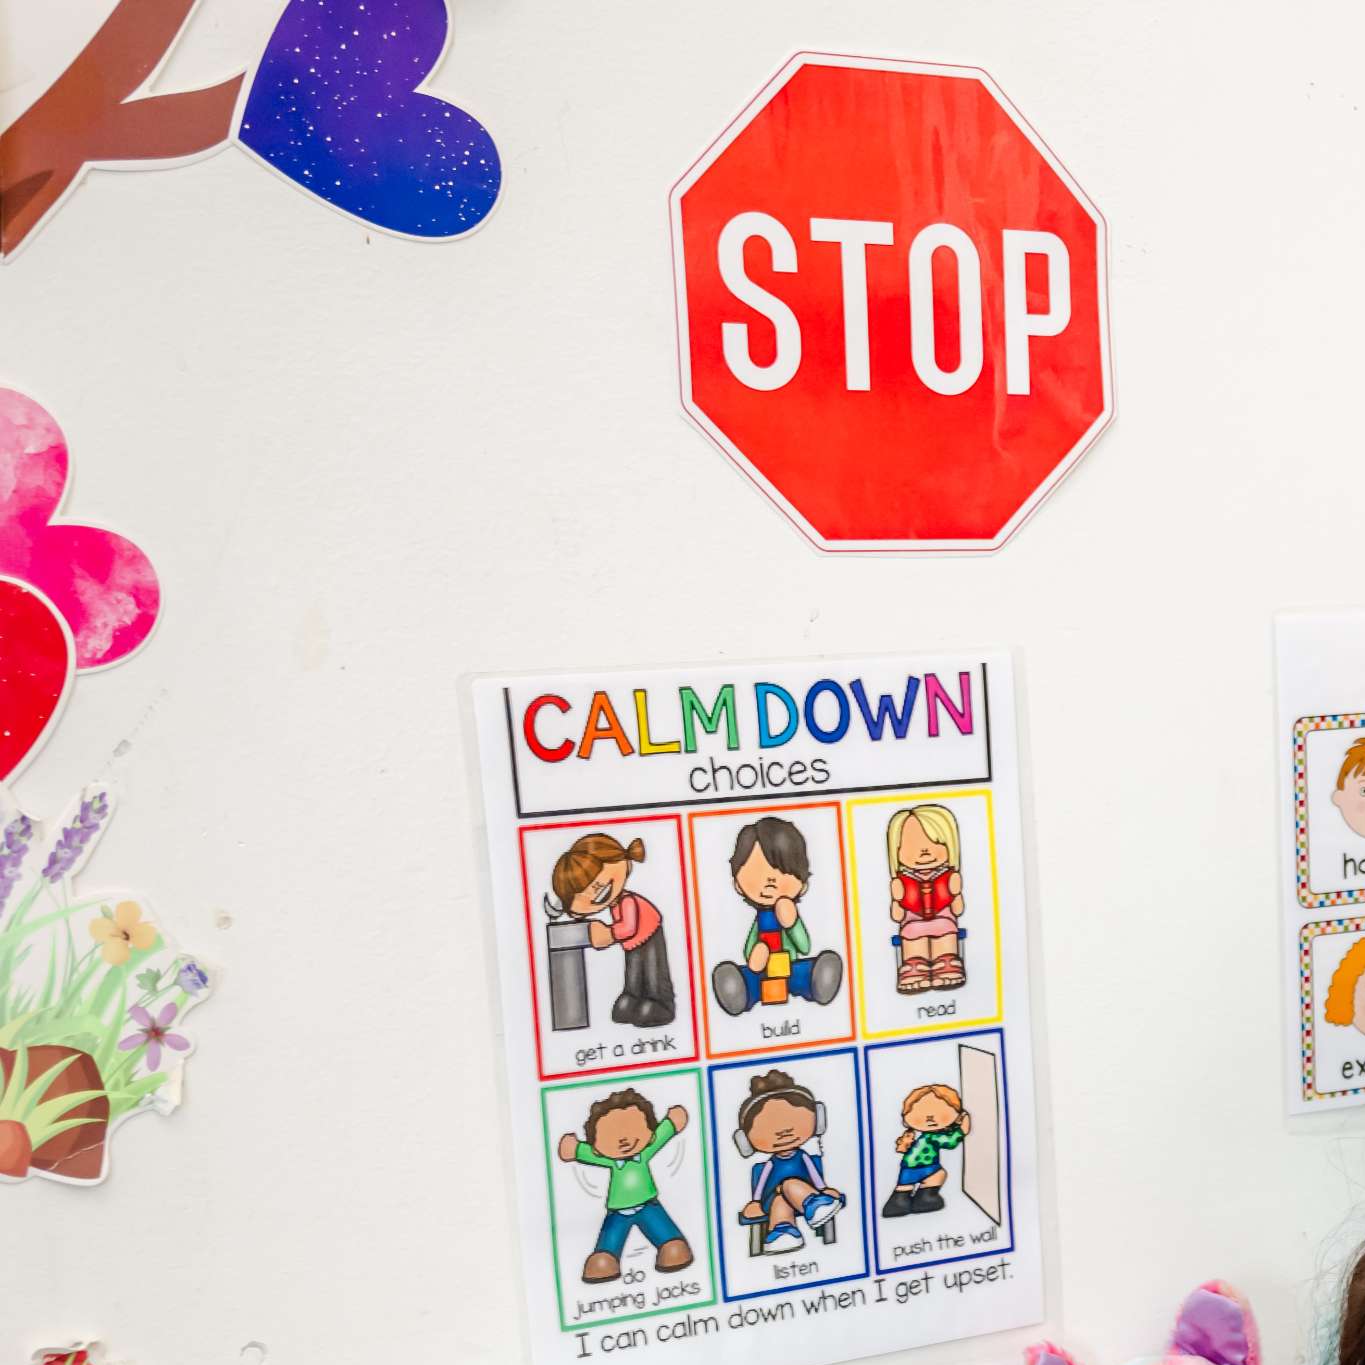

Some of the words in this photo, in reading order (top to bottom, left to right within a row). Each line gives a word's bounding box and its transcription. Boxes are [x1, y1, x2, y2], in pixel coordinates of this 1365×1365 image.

[716, 210, 1072, 396] STOP
[522, 682, 740, 764] CALM
[753, 670, 975, 749] DOWN
[688, 756, 832, 794] choices
[916, 999, 957, 1019] read
[759, 1019, 801, 1039] build
[575, 1041, 607, 1066] get
[612, 1043, 626, 1058] a
[631, 1035, 679, 1056] drink
[892, 1238, 934, 1262] push
[937, 1233, 966, 1250] the
[968, 1227, 998, 1246] wall
[622, 1266, 647, 1286] do
[773, 1259, 820, 1281] listen
[572, 1291, 647, 1321] jumping
[652, 1279, 702, 1307] jacks
[575, 1332, 594, 1360] I
[599, 1326, 649, 1355] can
[655, 1314, 721, 1344] calm
[728, 1298, 795, 1330] down
[802, 1286, 867, 1316] when
[874, 1278, 889, 1303] I
[895, 1272, 935, 1305] get
[942, 1258, 1016, 1300] upset.
